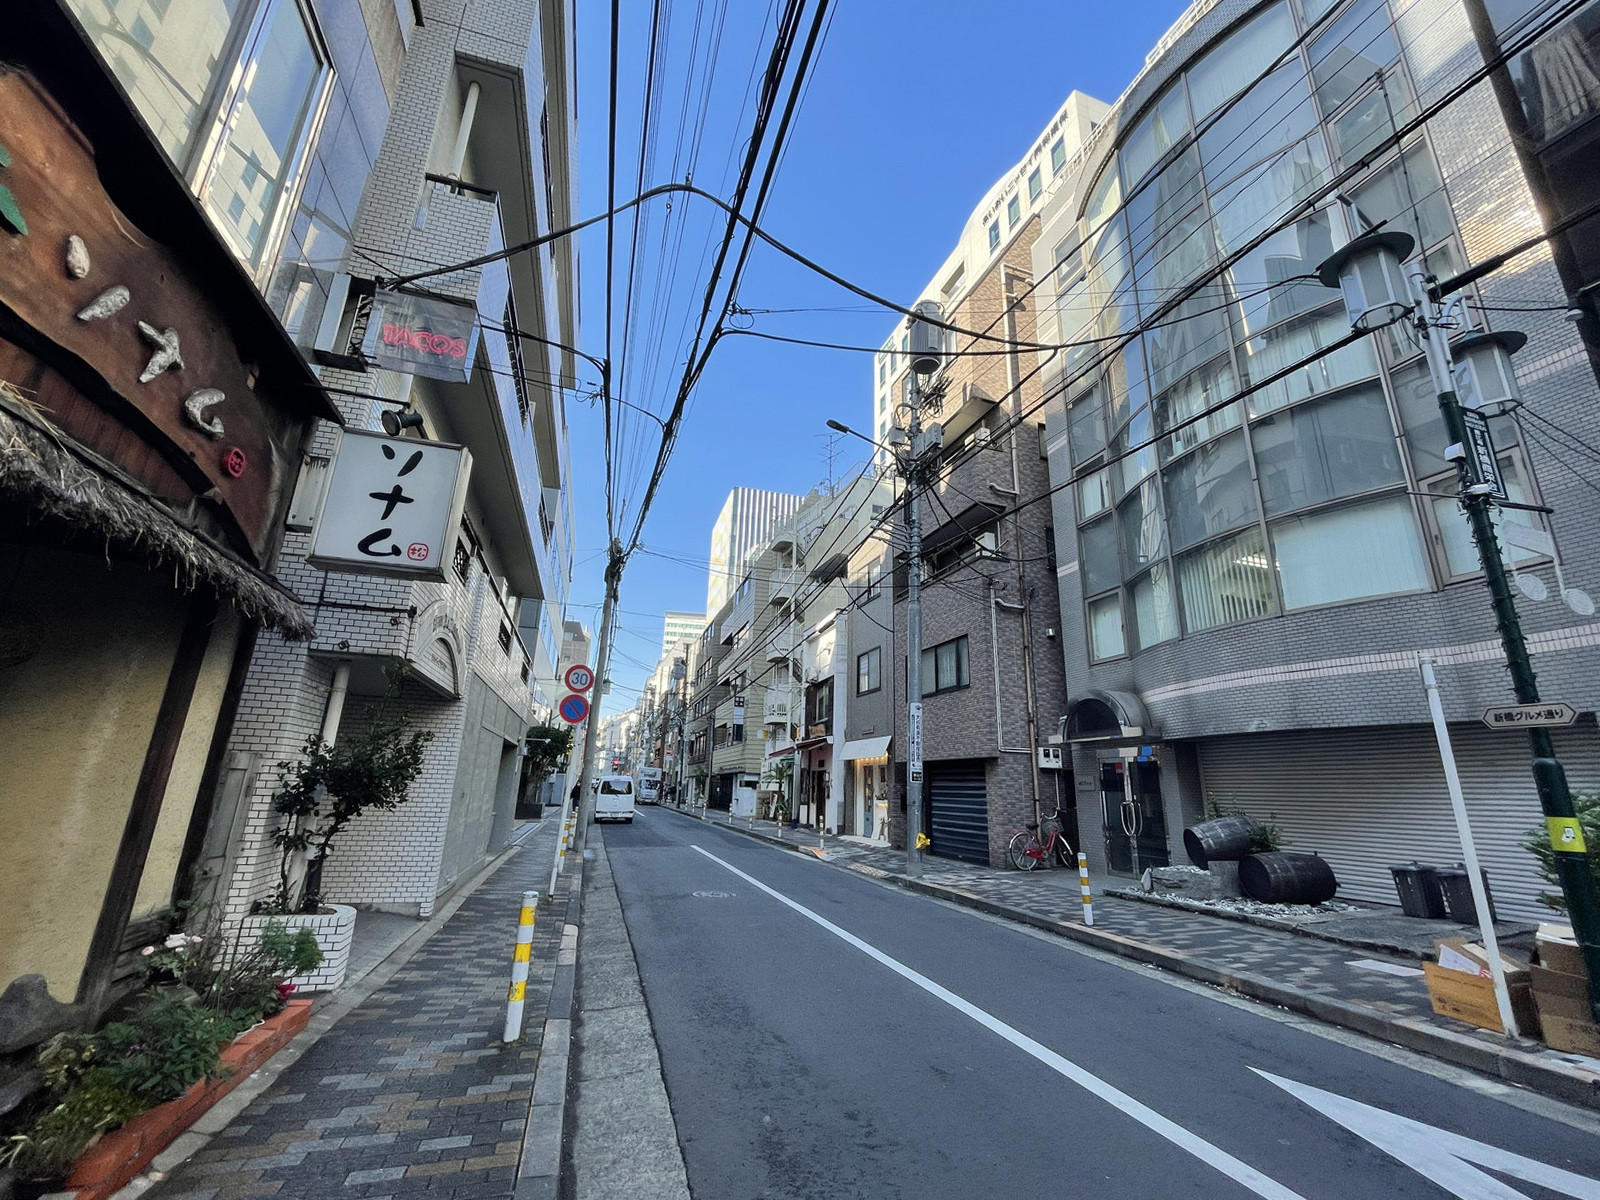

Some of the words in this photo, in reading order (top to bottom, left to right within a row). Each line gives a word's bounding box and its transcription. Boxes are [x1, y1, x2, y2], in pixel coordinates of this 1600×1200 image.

[383, 324, 466, 357] TACOS
[409, 545, 428, 559] 松
[571, 672, 589, 686] 30
[1494, 709, 1563, 722] 新橋グルメ通り
